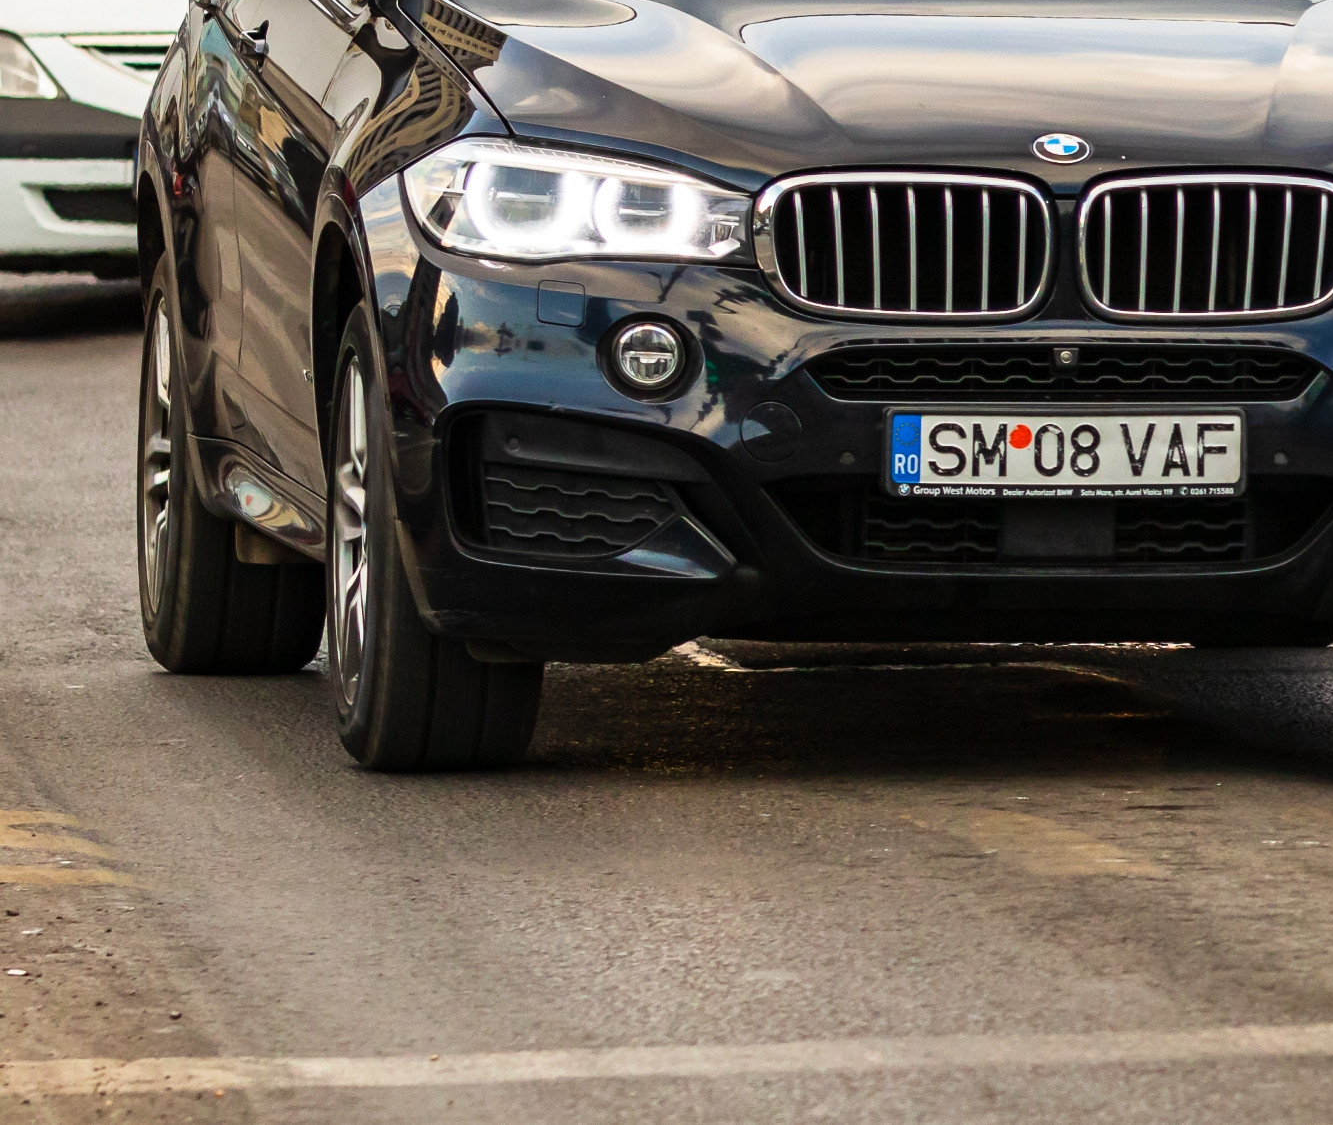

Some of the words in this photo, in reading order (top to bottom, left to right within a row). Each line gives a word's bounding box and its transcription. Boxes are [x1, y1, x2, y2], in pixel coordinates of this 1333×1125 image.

[928, 422, 1008, 477] SM
[1034, 423, 1101, 477] 08
[1120, 423, 1235, 477] VAF
[894, 454, 919, 475] RO
[913, 485, 941, 497] Group
[942, 486, 963, 495] West
[965, 486, 996, 496] Motors
[1002, 488, 1024, 496] Dealer
[1025, 488, 1056, 496] Autorizat
